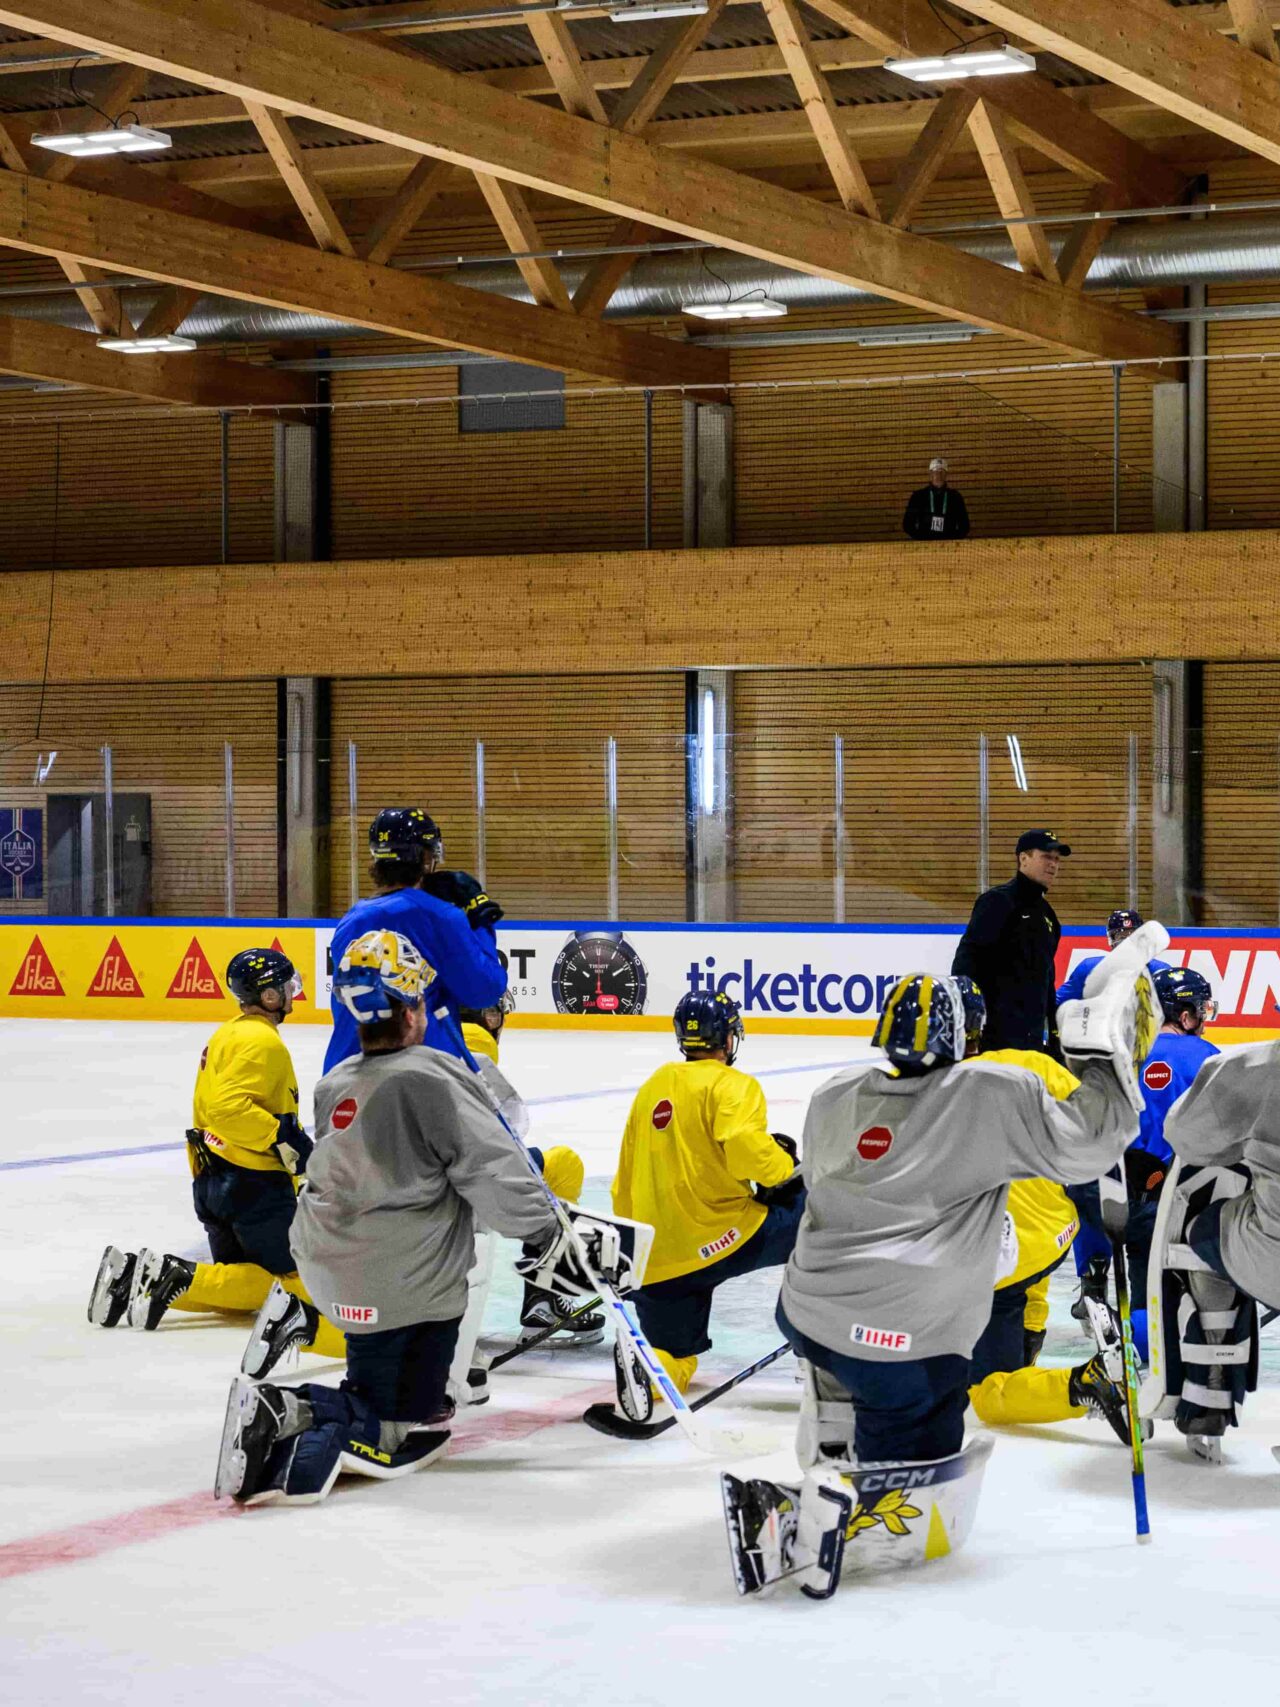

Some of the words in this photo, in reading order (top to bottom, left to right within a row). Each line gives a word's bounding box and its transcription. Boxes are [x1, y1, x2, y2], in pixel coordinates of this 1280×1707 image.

[3, 842, 32, 850] ITALIA
[378, 832, 389, 842] 34
[15, 955, 56, 990] Sika
[94, 955, 135, 992] Sika
[173, 956, 215, 993] Sika
[686, 1019, 699, 1031] 26
[709, 1229, 736, 1254] IIHF
[341, 1306, 373, 1321] IIHF
[865, 1329, 906, 1348] IIHF
[350, 1440, 392, 1464] TRUE
[860, 1468, 936, 1492] CCM
